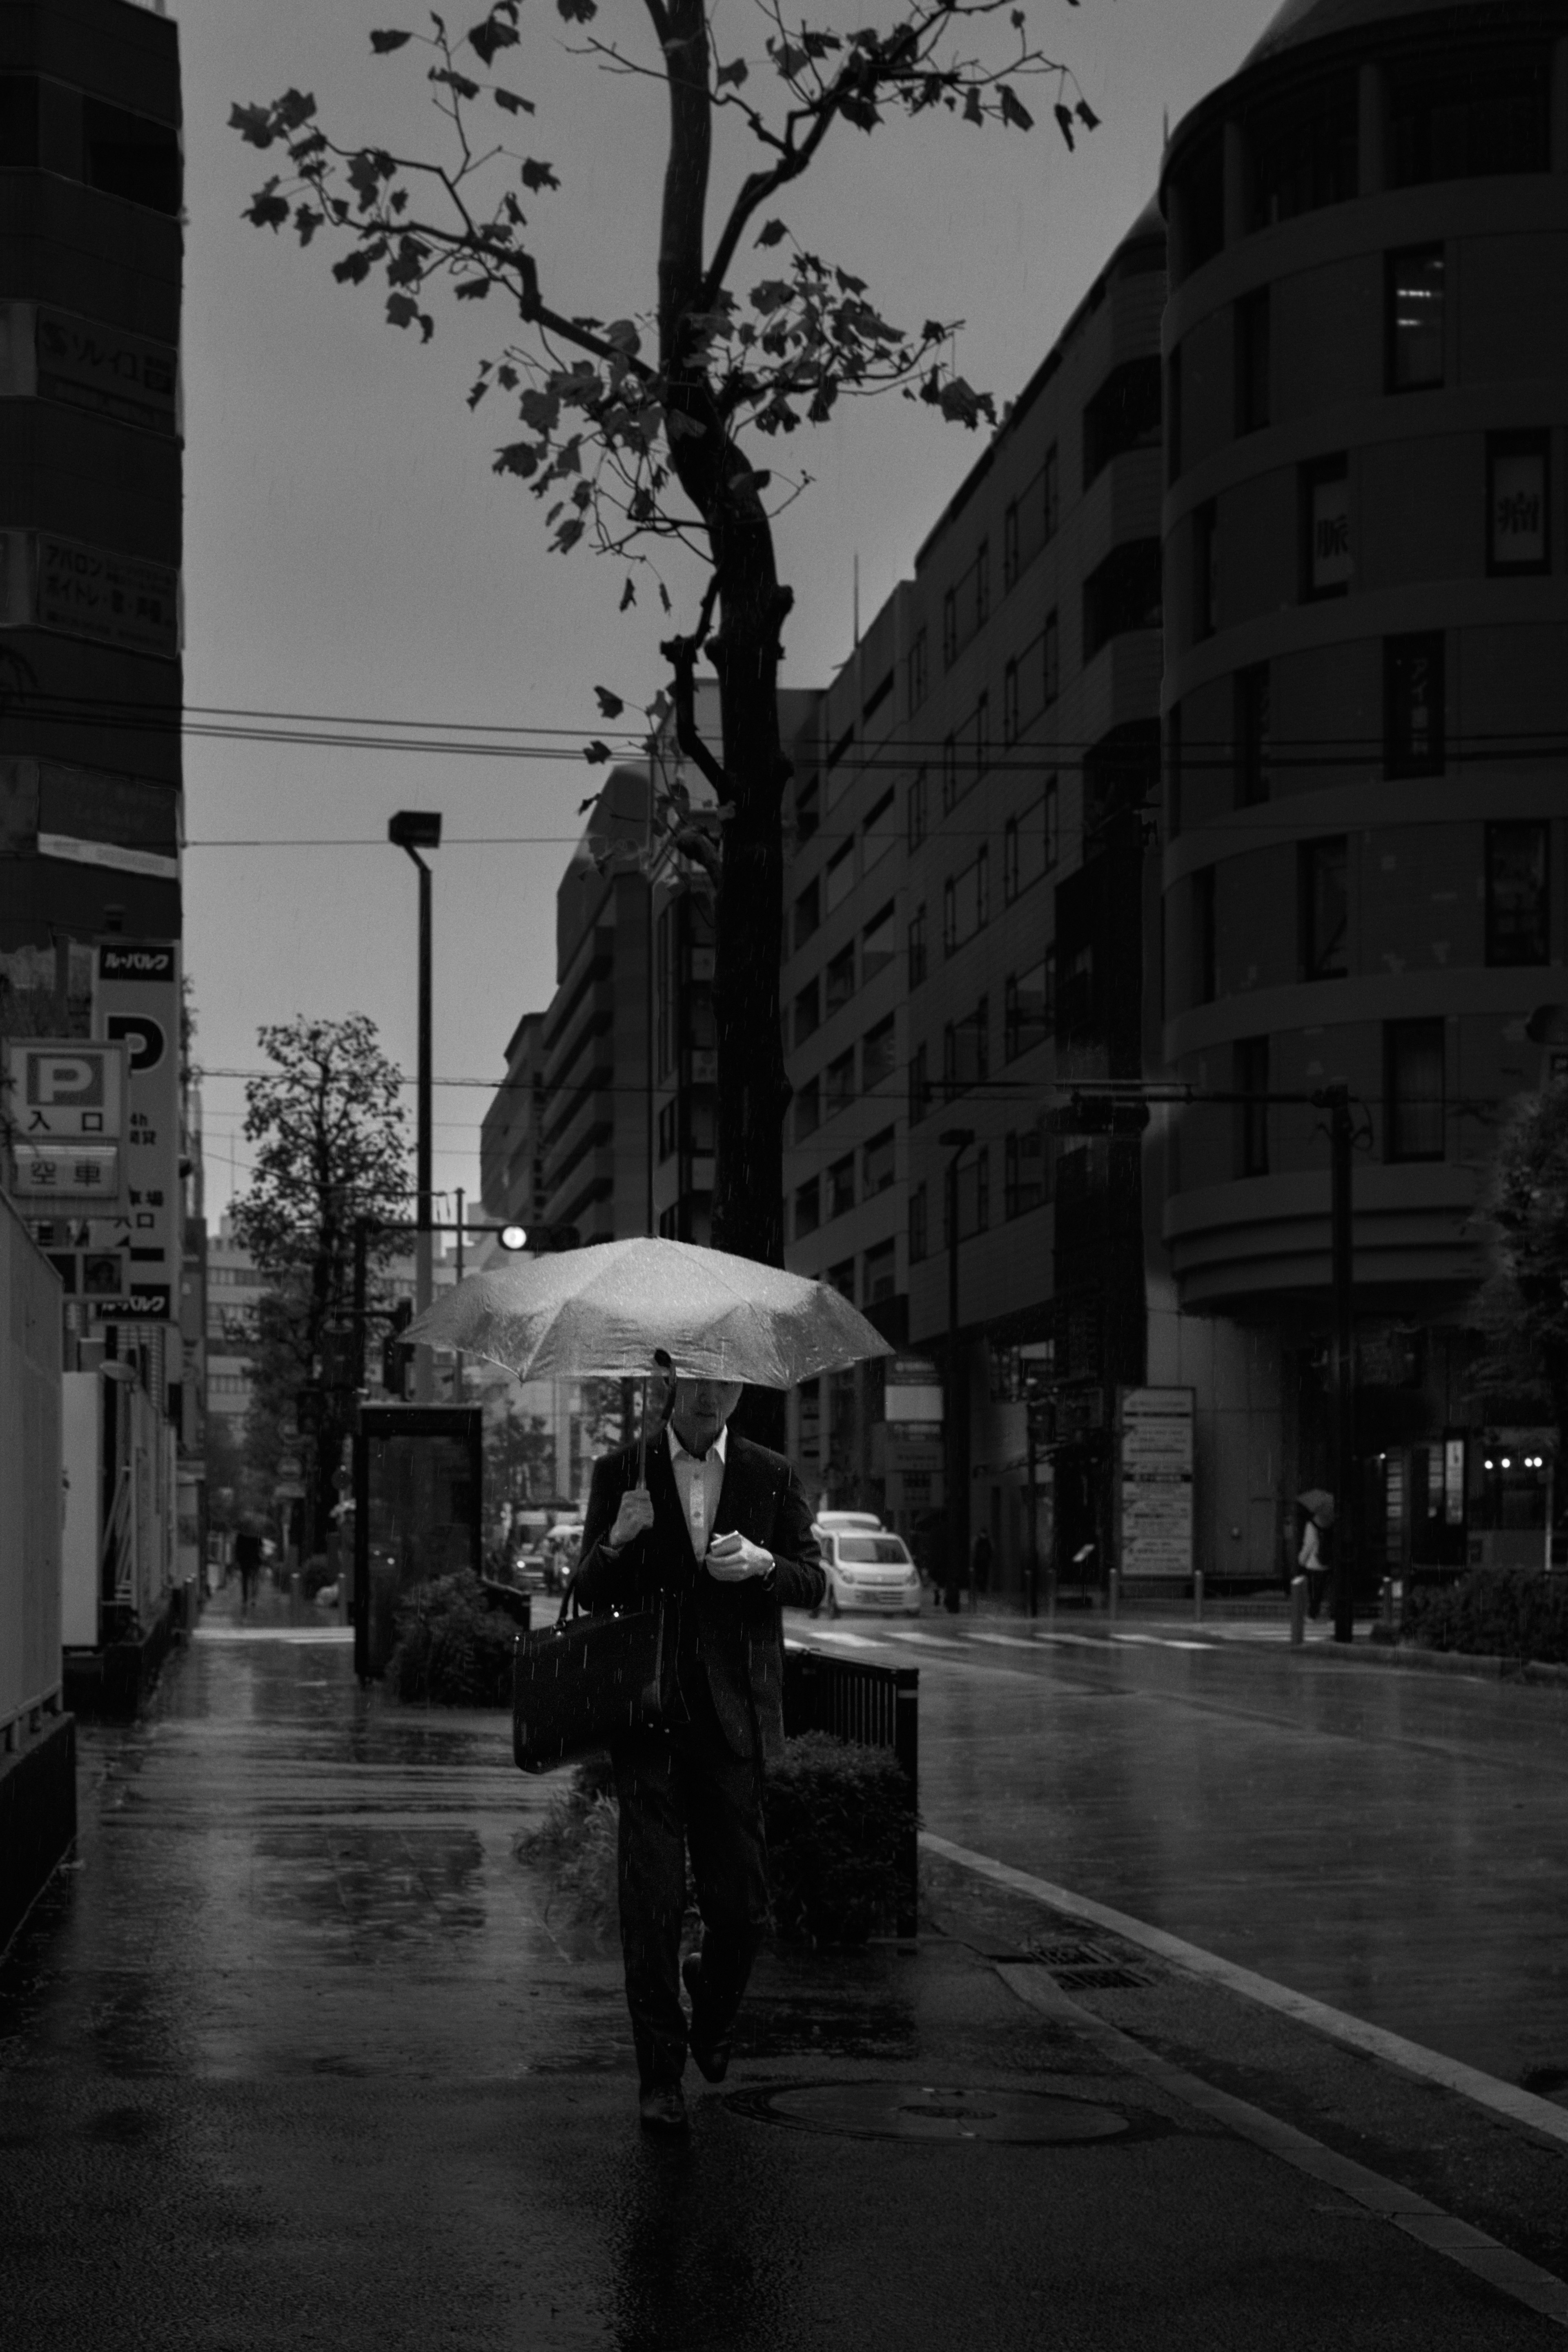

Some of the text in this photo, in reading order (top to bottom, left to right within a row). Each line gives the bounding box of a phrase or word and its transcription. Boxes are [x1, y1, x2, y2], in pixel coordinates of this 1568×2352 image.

[38, 1057, 93, 1102] P
[29, 1111, 103, 1132] 入口
[31, 1159, 101, 1186] 空車
